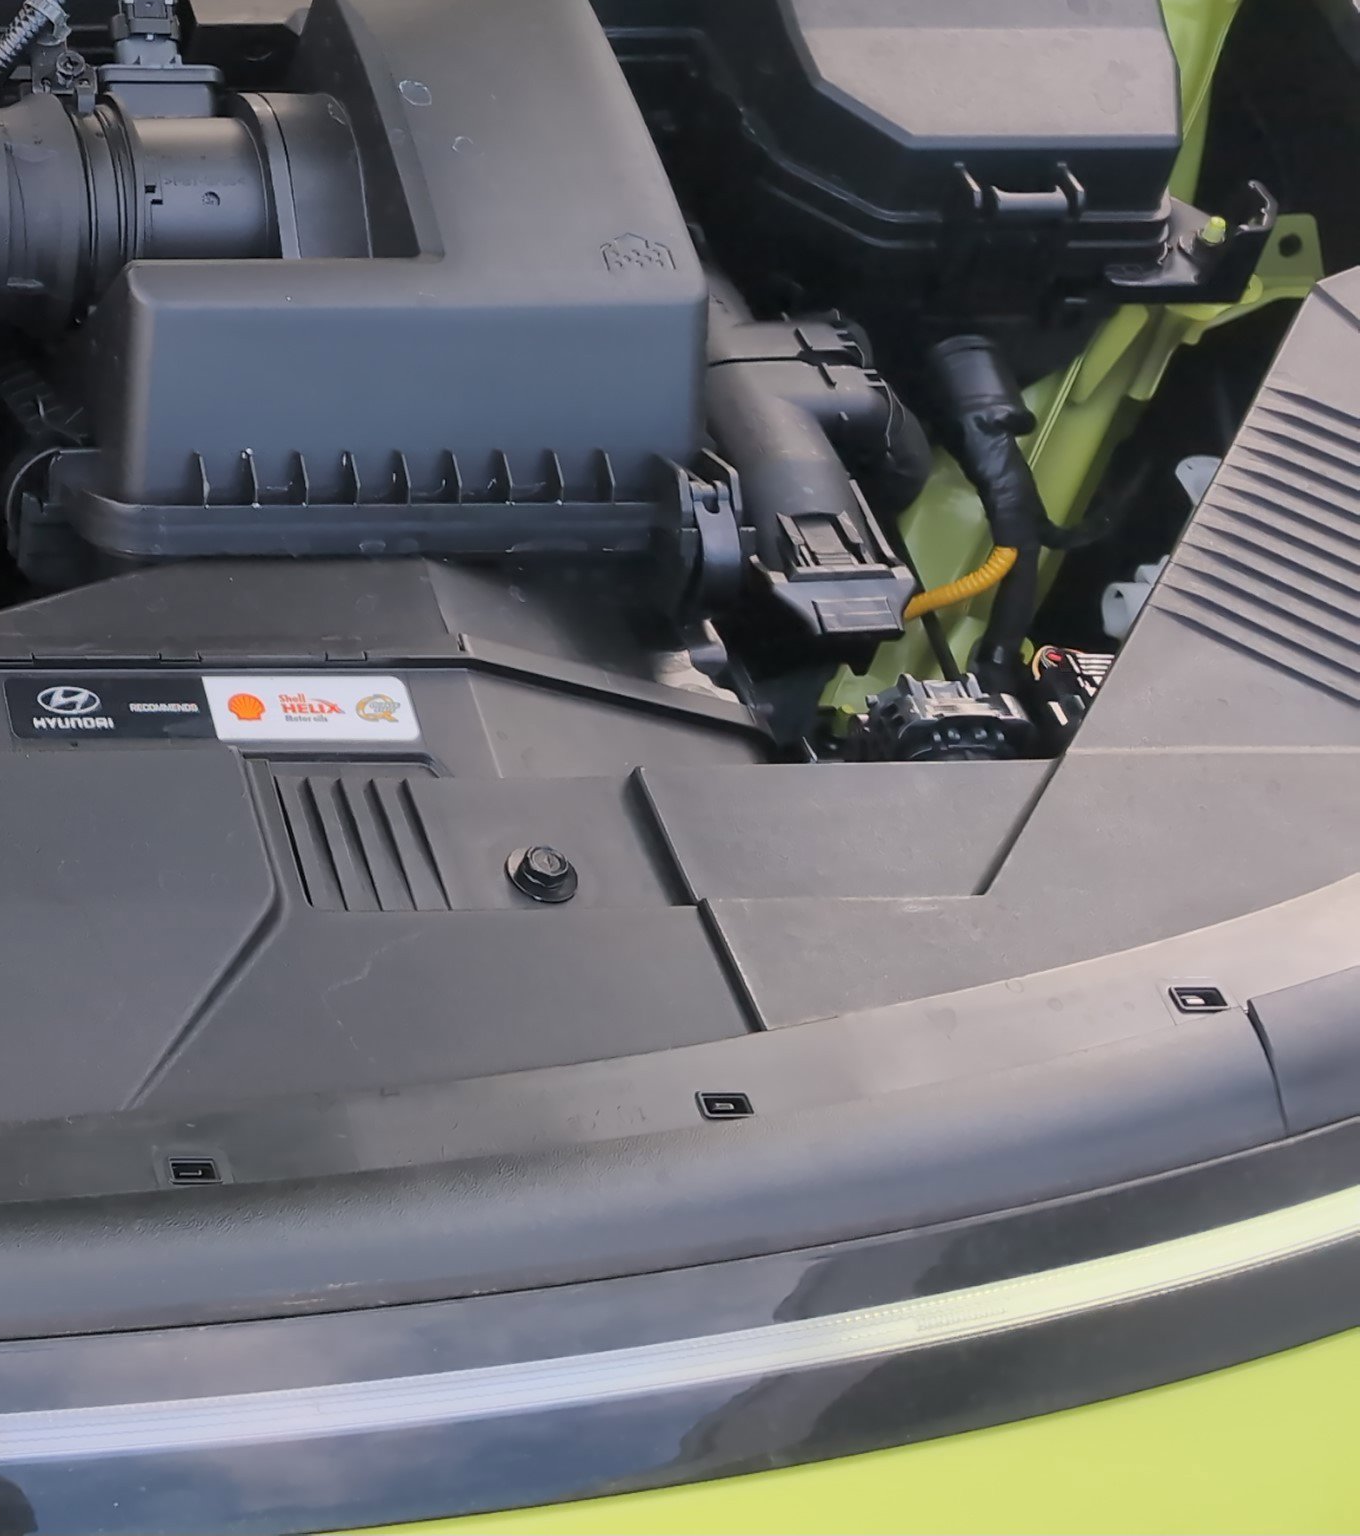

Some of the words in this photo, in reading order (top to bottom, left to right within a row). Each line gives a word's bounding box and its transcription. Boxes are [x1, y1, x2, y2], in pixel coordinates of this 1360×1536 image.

[278, 693, 306, 705] Shell
[129, 702, 199, 713] RECOMMENDS
[281, 703, 343, 715] HELIX
[32, 716, 115, 731] HYUNDAI
